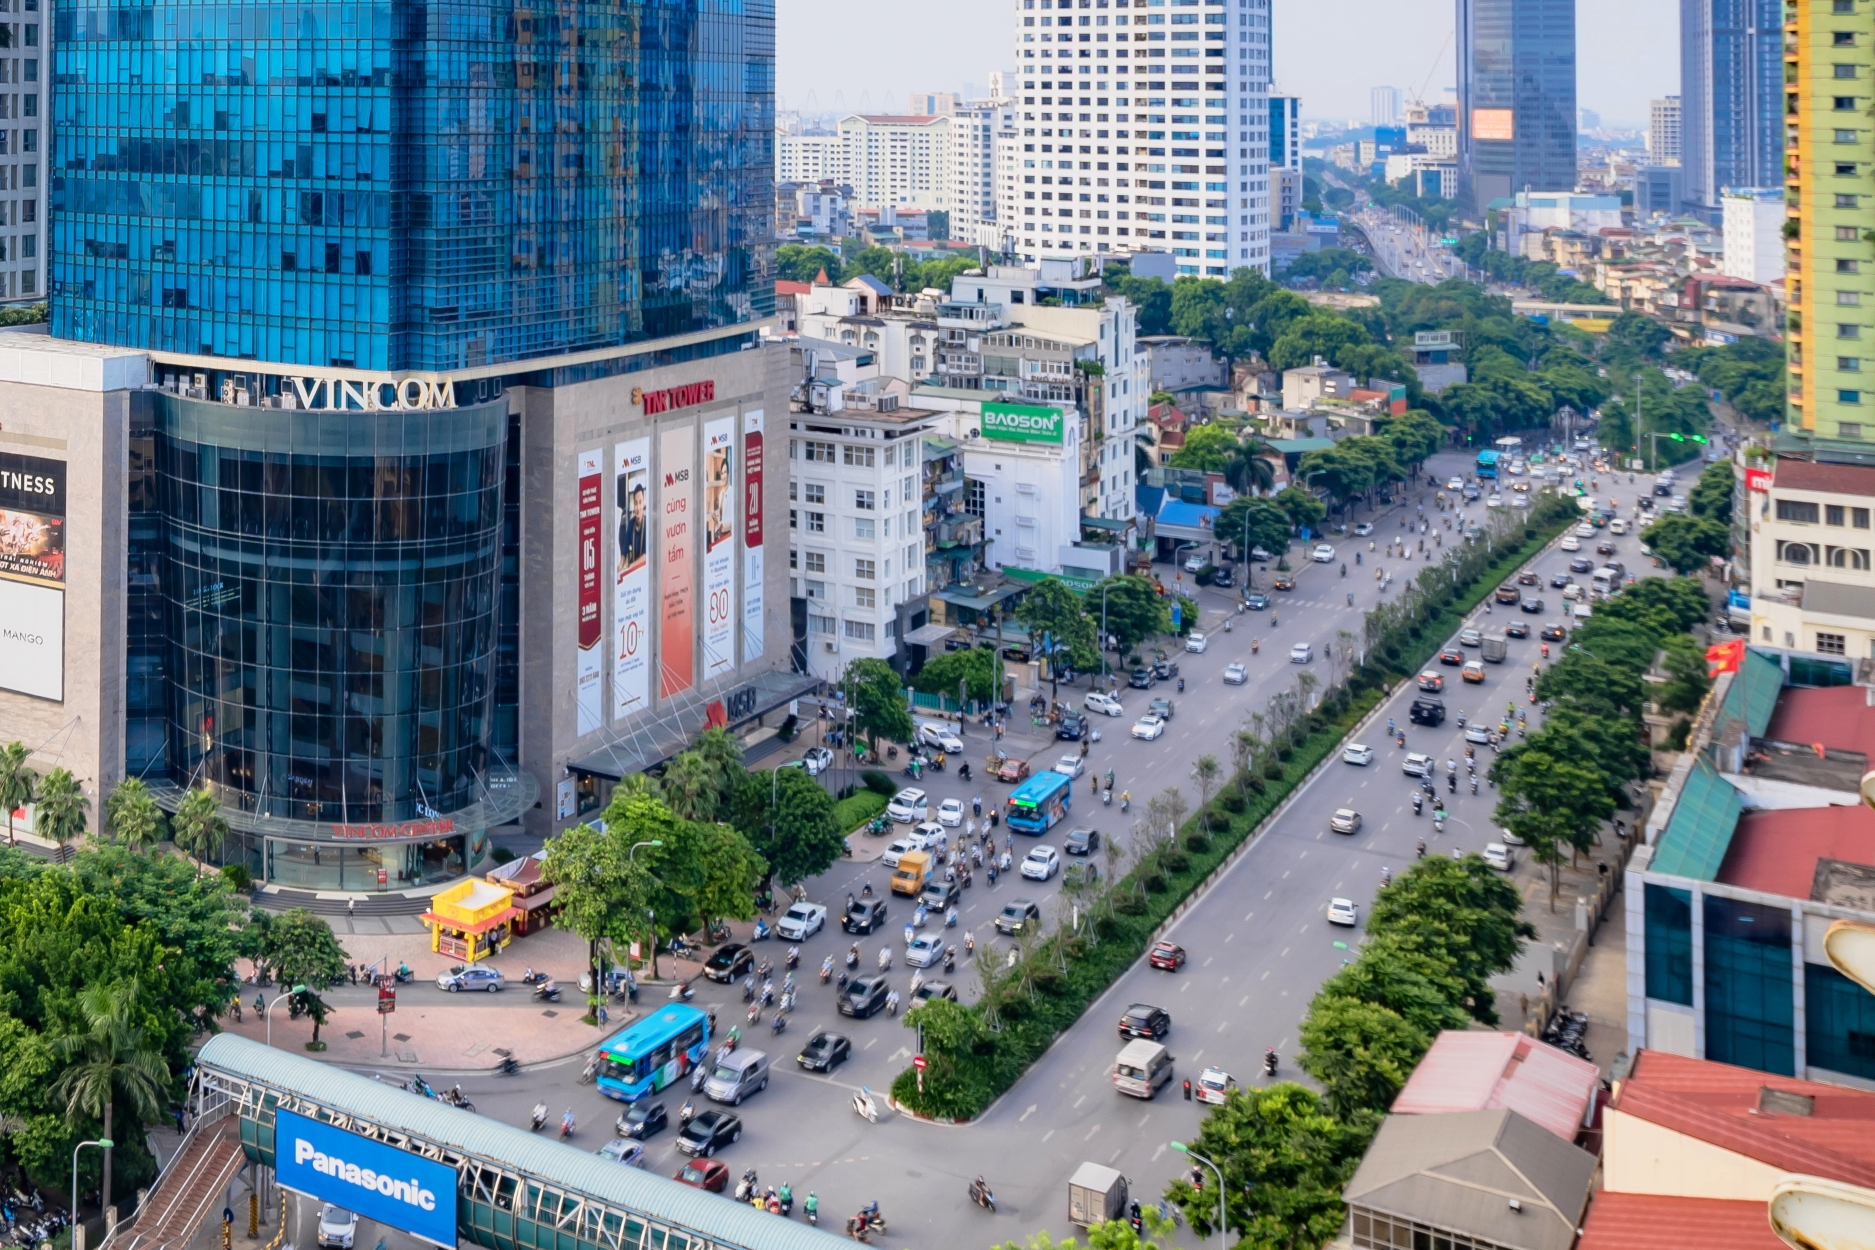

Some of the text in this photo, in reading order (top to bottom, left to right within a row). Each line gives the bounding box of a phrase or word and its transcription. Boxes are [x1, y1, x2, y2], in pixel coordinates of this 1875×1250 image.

[291, 376, 459, 411] VINCOM
[642, 380, 714, 416] TNR TOWER
[718, 433, 727, 442] MSB
[630, 455, 641, 465] MSB
[674, 469, 689, 483] MSB
[666, 497, 686, 514] cùng
[749, 482, 758, 515] 20
[666, 522, 686, 539] vươn
[584, 538, 595, 571] 05
[668, 544, 684, 563] tầm
[3, 628, 43, 645] MANGO
[619, 621, 638, 660] 10
[727, 687, 756, 721] MSB
[332, 818, 454, 838] VINCOM CENTER
[295, 1138, 436, 1211] Panasonic
